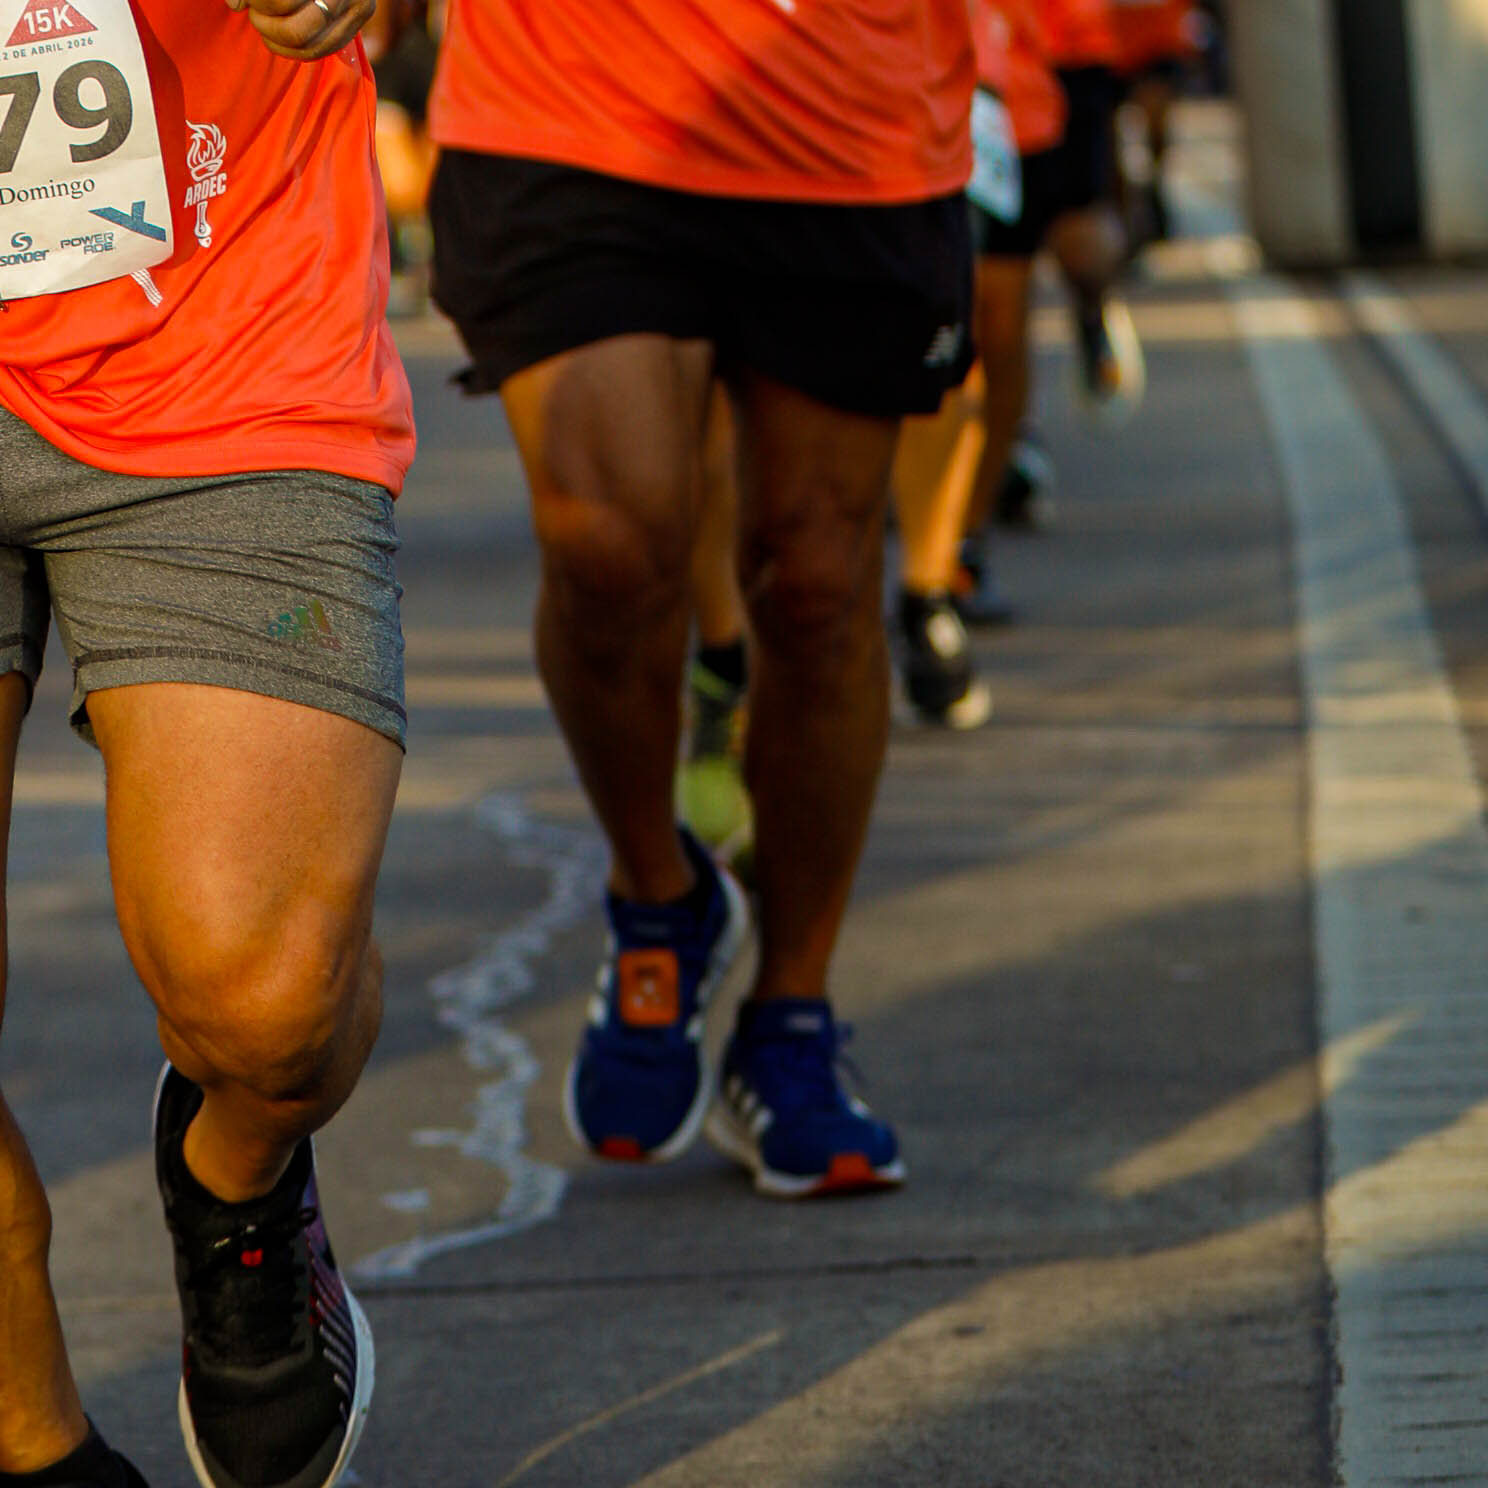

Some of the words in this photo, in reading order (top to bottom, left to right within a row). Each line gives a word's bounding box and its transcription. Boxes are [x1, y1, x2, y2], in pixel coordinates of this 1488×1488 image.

[23, 4, 74, 35] 15K
[12, 47, 28, 59] DE
[31, 42, 64, 56] ABRIL
[67, 36, 94, 49] 2026
[184, 172, 227, 209] ARDEC
[60, 232, 114, 249] POWER
